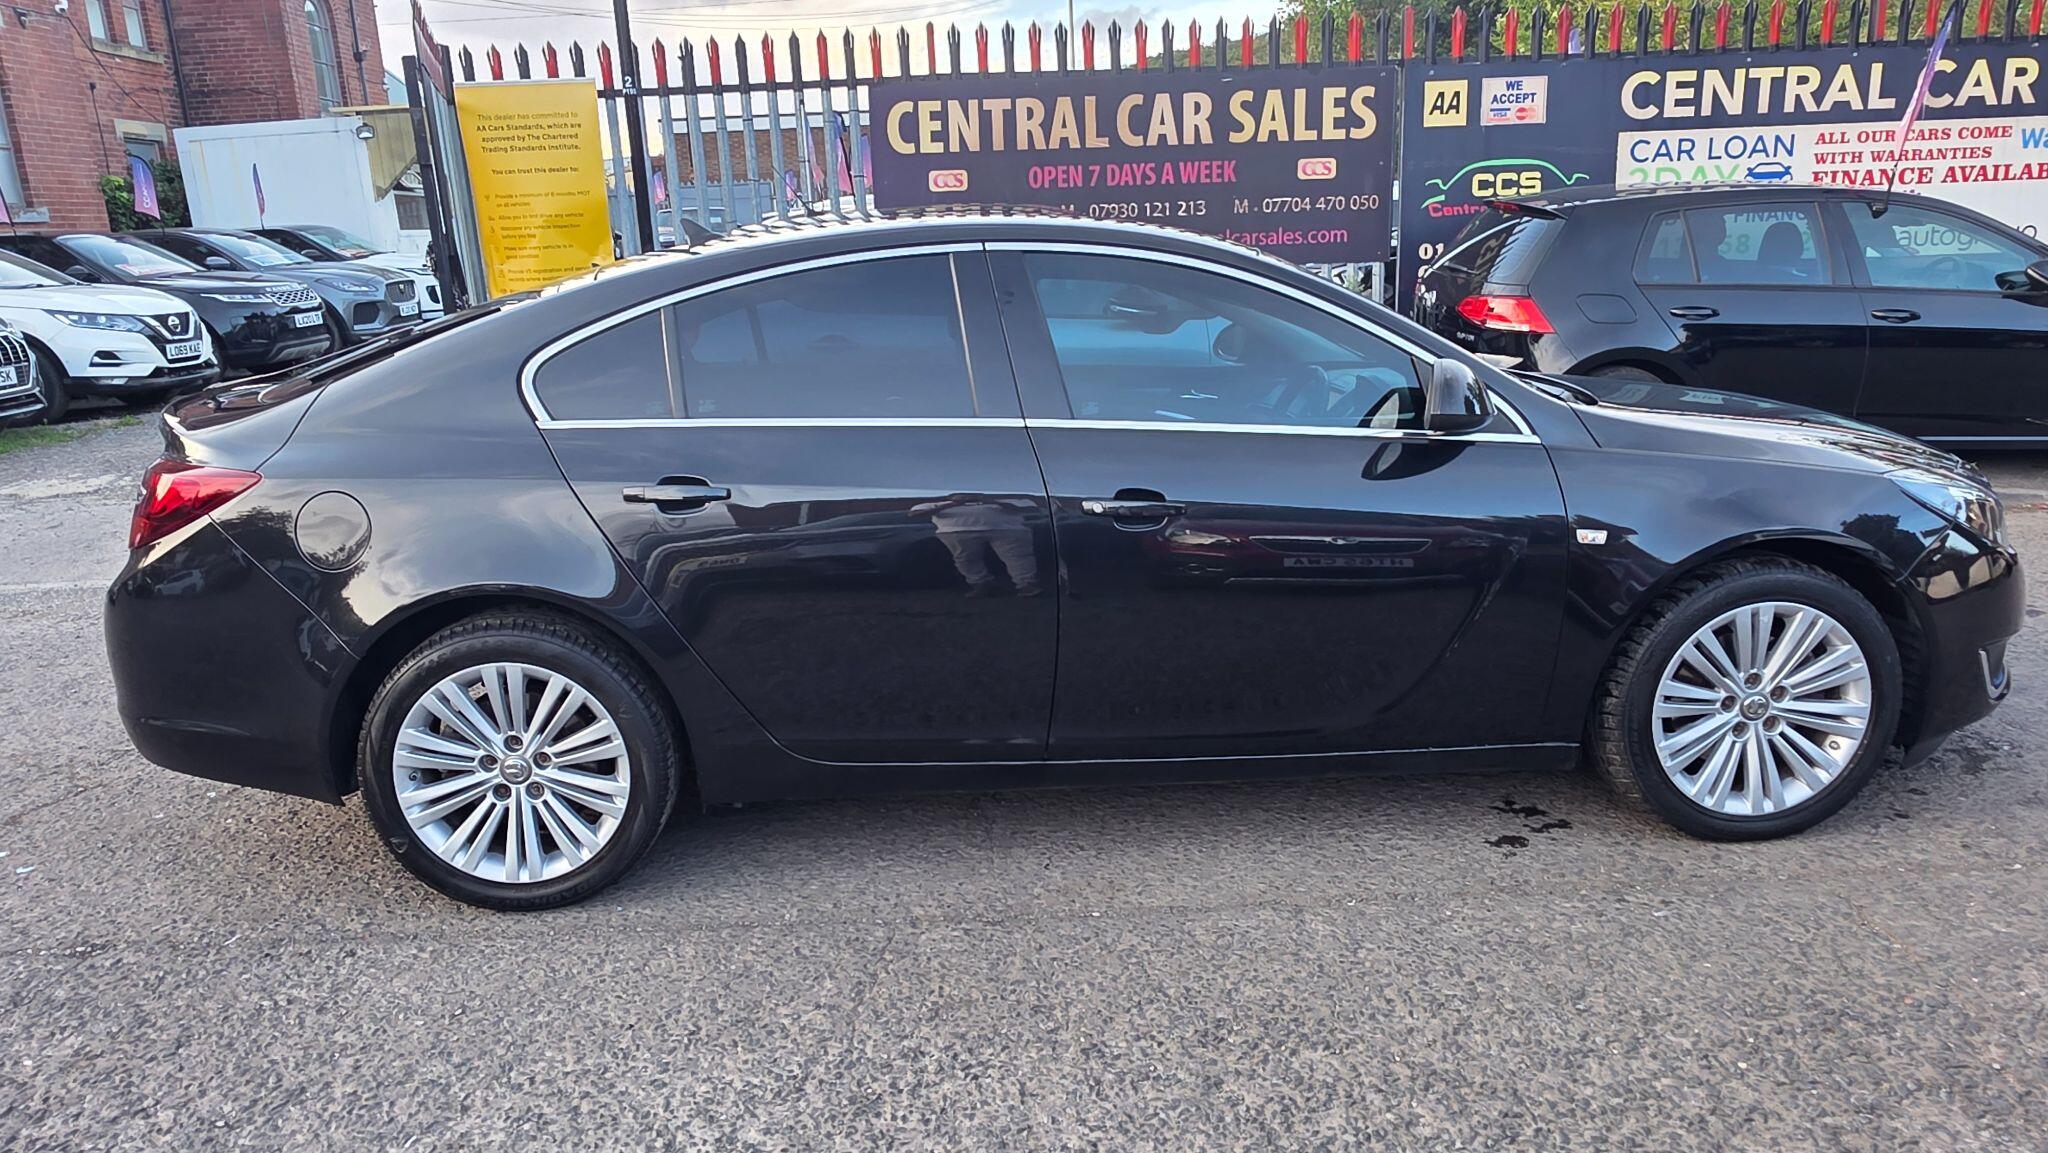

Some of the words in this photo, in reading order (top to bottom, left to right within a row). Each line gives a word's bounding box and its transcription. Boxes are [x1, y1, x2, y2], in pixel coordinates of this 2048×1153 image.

[1506, 80, 1524, 91] WE
[1621, 62, 1896, 120] CENTRAL
[1917, 58, 2040, 108] CAR
[1429, 90, 1461, 116] AA
[1491, 92, 1536, 104] ACCEPT
[886, 95, 1110, 154] CENTRAL
[1116, 92, 1214, 148] CAR
[1228, 85, 1377, 144] SALES
[1815, 132, 1850, 145] ALL
[1857, 130, 1896, 144] OUR
[1904, 127, 1951, 142] CARS
[1958, 126, 2013, 139] COME
[1630, 138, 1696, 164] CAR
[1708, 134, 1796, 160] LOAN
[1814, 150, 1862, 164] WITH
[1870, 146, 1993, 163] WARRANTIES
[1028, 165, 1083, 189] OPEN
[1088, 165, 1100, 187] 7
[1106, 163, 1156, 186] DAYS
[1161, 162, 1174, 185] A
[1178, 160, 1237, 184] WEEK
[1301, 160, 1332, 176] CCS
[1812, 166, 1934, 187] FINANCE
[933, 172, 964, 188] CCS
[1472, 171, 1542, 197] CCS
[1089, 202, 1138, 218] 07930
[1144, 202, 1170, 217] 121
[1177, 200, 1206, 216] 213
[1234, 198, 1249, 214] M
[1263, 197, 1311, 213] 07704
[1316, 196, 1345, 211] 470
[1350, 195, 1379, 210] 050
